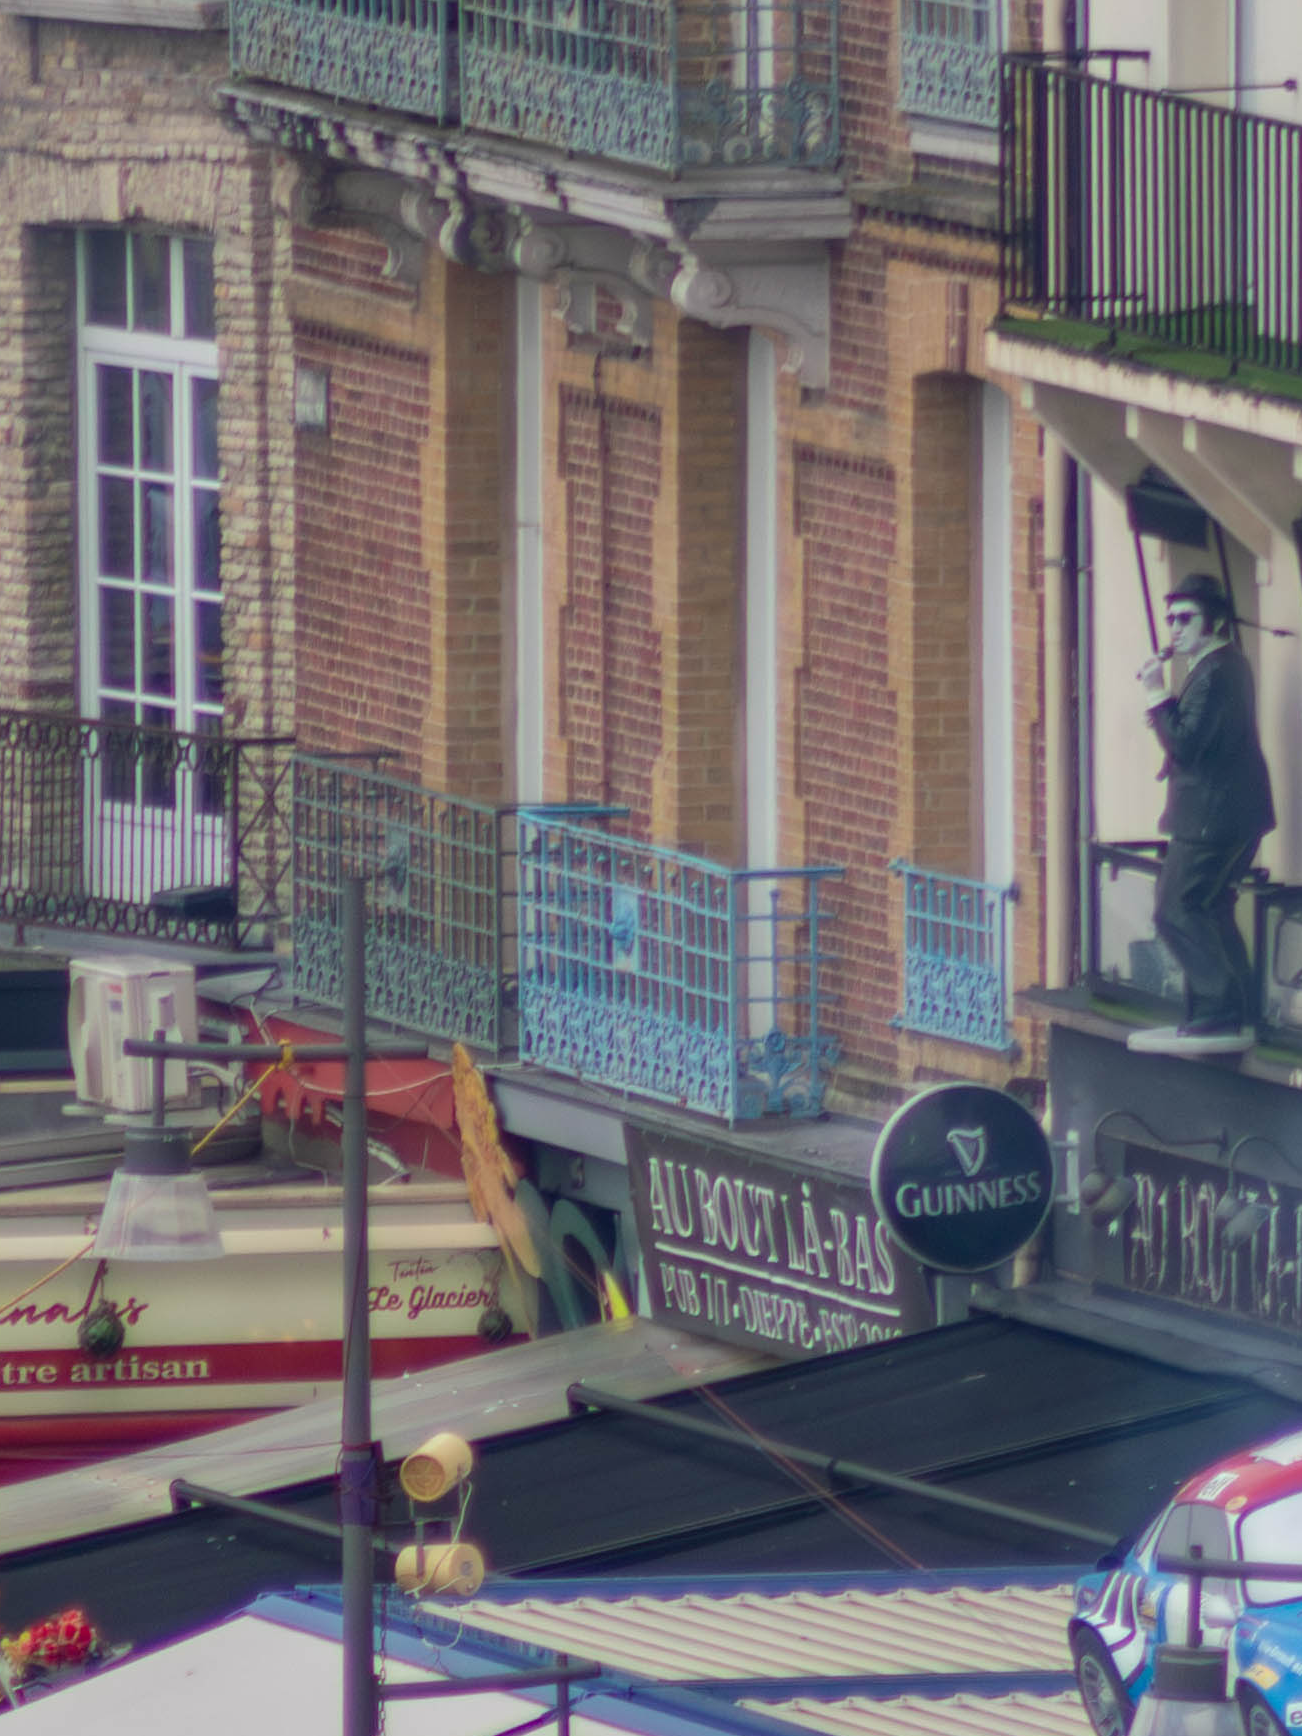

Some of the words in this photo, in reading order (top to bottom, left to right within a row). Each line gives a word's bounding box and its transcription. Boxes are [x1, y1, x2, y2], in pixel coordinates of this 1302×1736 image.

[649, 1157, 693, 1238] AU
[694, 1168, 778, 1263] BOUT
[896, 1171, 1042, 1218] GUINNESS
[407, 1284, 491, 1320] Glacier
[659, 1262, 700, 1316] PUB
[738, 1286, 815, 1350] DIEPPE
[70, 1356, 210, 1383] artisan
